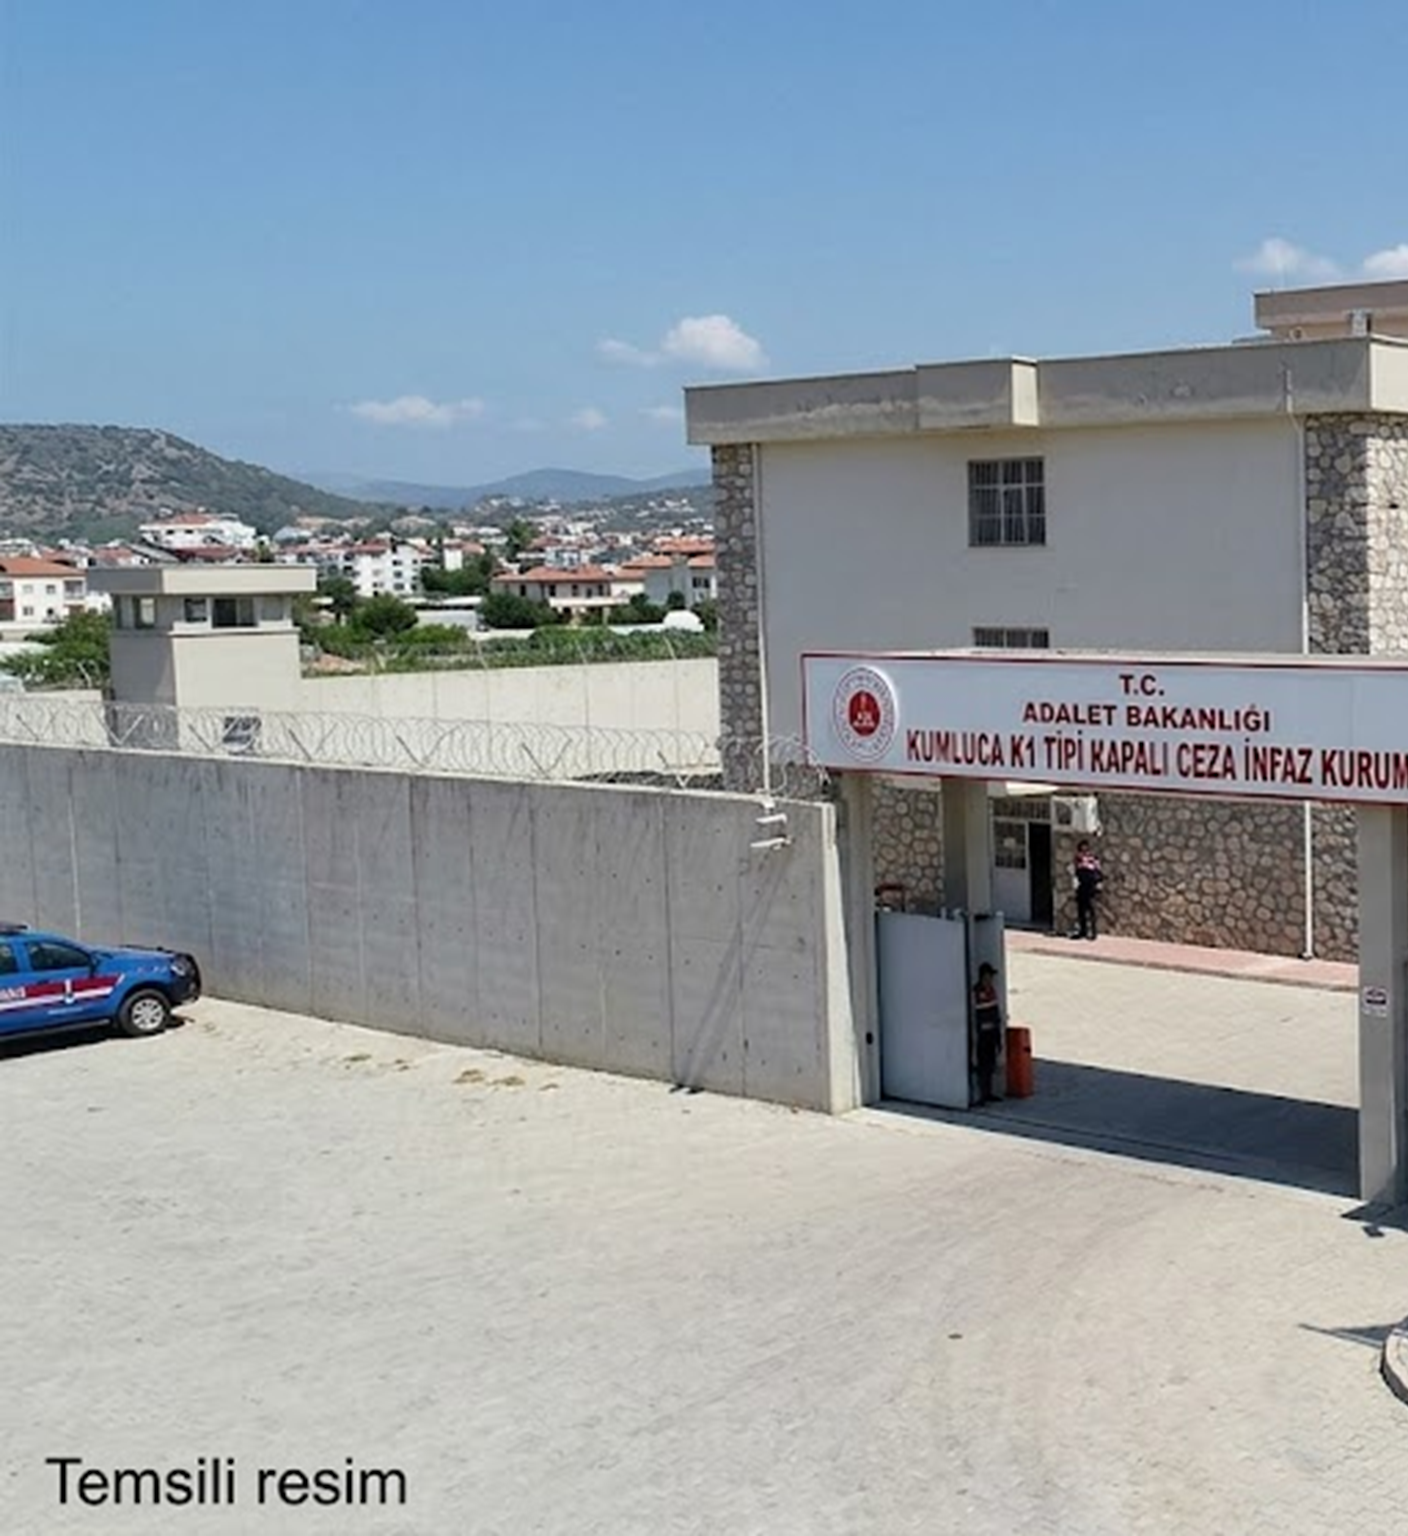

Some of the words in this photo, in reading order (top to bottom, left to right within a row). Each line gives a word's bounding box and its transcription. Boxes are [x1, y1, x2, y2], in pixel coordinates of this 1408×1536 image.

[1119, 674, 1165, 696] T.C.
[1022, 702, 1117, 726] ADALET
[1126, 704, 1270, 732] BAKANLIĞI
[906, 729, 1004, 767] KUMLUCA
[1011, 734, 1036, 768] K1
[1043, 730, 1084, 771] TİPİ
[1091, 739, 1169, 776] KAPALI
[1176, 742, 1236, 781] CEZA
[1244, 737, 1313, 784] İNFAZ
